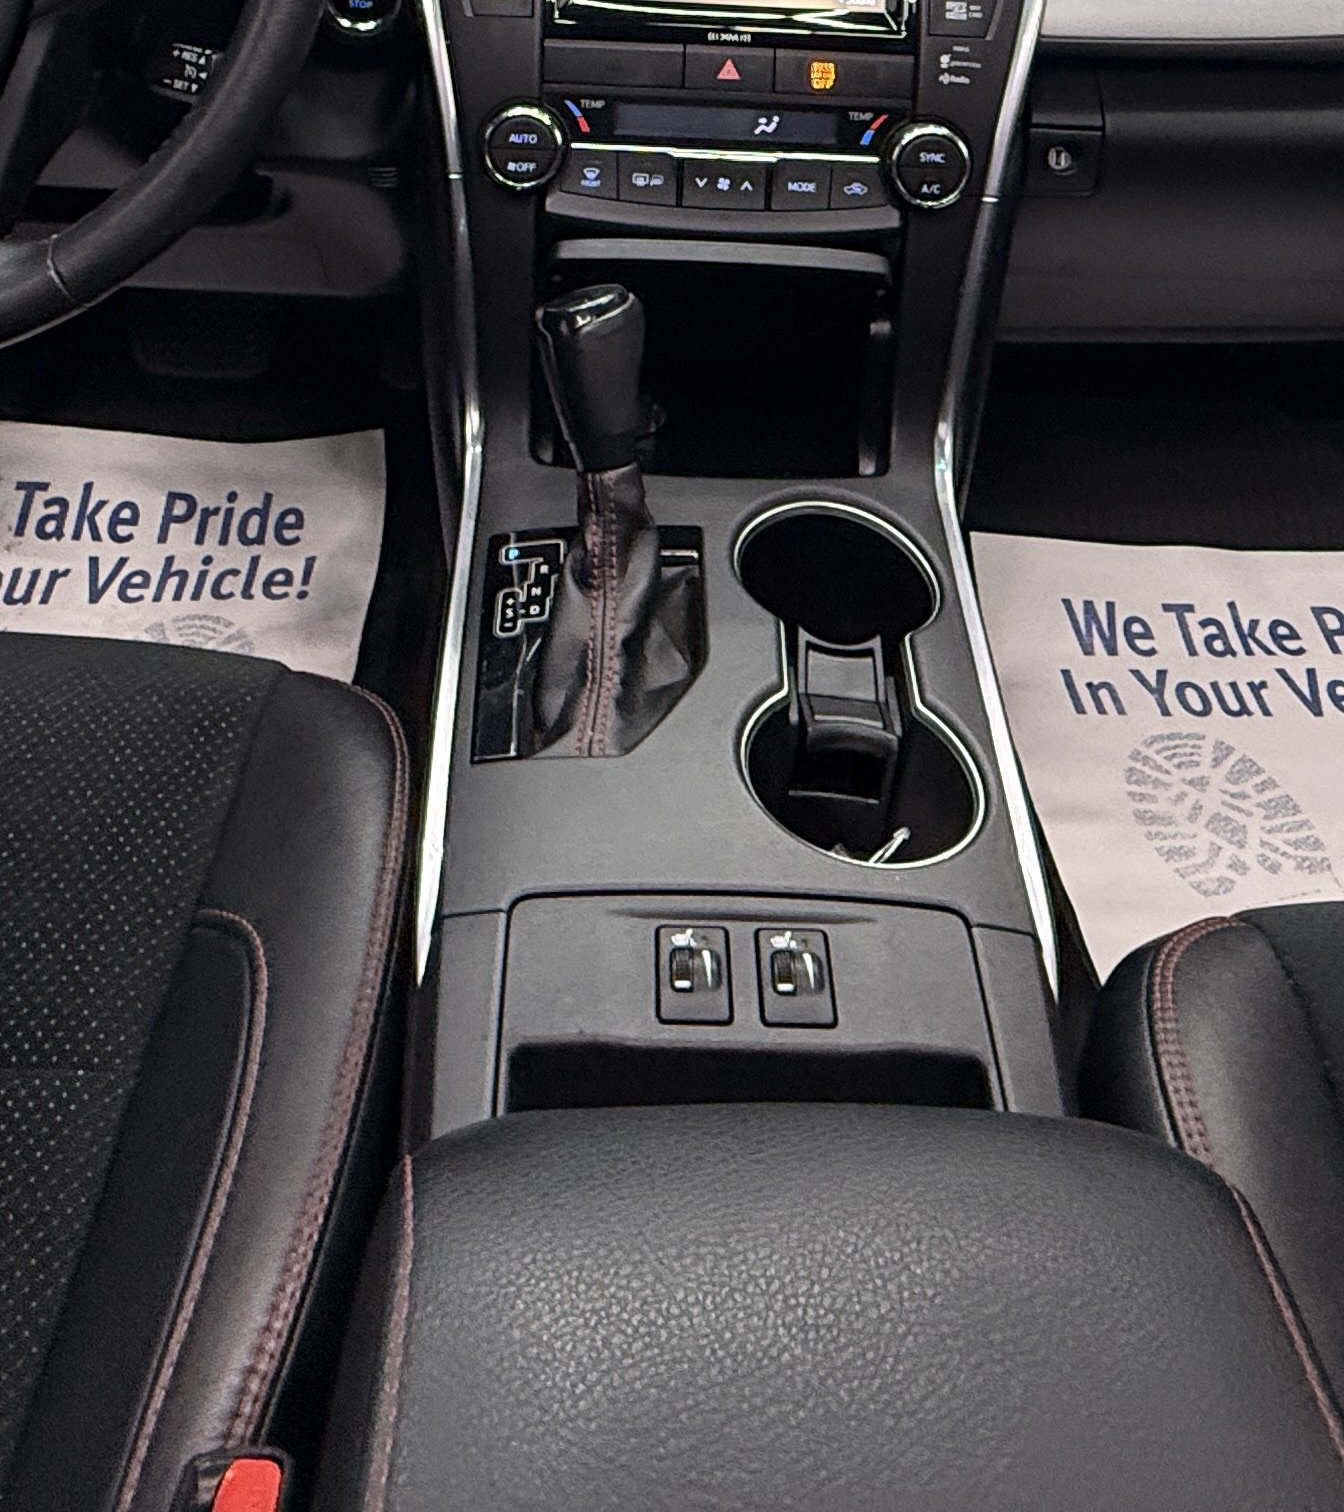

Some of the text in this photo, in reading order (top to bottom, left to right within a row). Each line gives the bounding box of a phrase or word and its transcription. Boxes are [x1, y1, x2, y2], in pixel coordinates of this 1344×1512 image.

[348, 0, 374, 9] STOP
[579, 98, 606, 109] TEMP
[848, 111, 875, 122] TEMP
[508, 133, 538, 145] AUTO
[918, 152, 946, 165] SYNC
[517, 162, 537, 173] OFF
[787, 181, 817, 194] MODE
[921, 183, 941, 195] A/C
[12, 481, 141, 545] Take
[156, 490, 305, 548] Pride
[509, 548, 520, 560] P
[85, 555, 318, 606] Vehicle!
[531, 586, 542, 596] N
[505, 608, 515, 619] S
[530, 605, 540, 615] D
[1060, 597, 1156, 658] We
[1160, 601, 1304, 658] Take
[1059, 668, 1128, 717] In
[1130, 668, 1272, 718] Your
